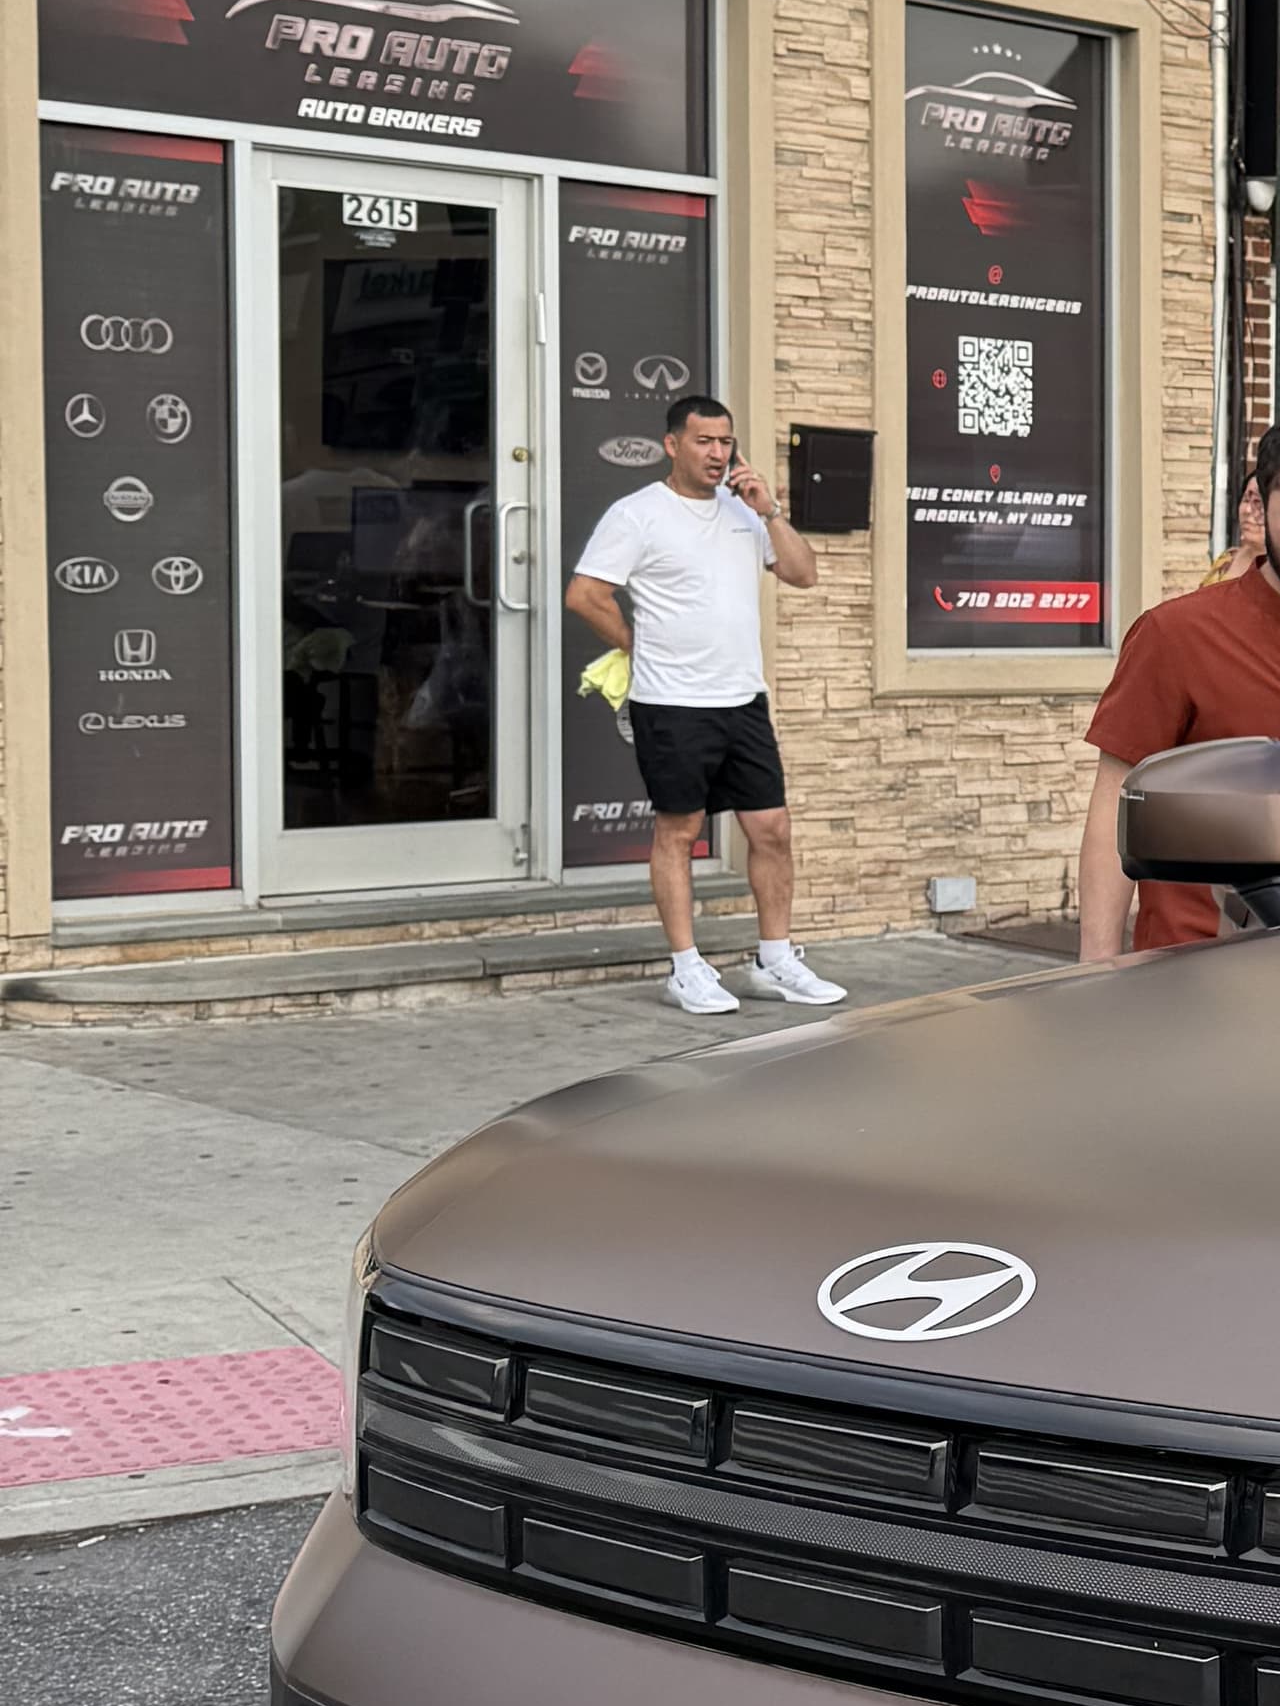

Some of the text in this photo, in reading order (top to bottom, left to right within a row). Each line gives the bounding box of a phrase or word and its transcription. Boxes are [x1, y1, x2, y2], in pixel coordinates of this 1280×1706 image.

[265, 13, 512, 79] PRO AUTO
[304, 63, 476, 103] LEASING
[298, 97, 484, 138] AUTO BROKERS
[921, 102, 1072, 146] PRO AUTO
[944, 134, 1050, 161] LEASING
[50, 171, 201, 204] PRO AUTO
[347, 195, 414, 228] 2615
[568, 224, 687, 253] PRO AUTO
[987, 264, 1004, 285] @
[613, 440, 652, 461] Ford
[941, 487, 994, 504] CONEY
[996, 491, 1055, 507] ISLAND
[1055, 493, 1088, 508] AVE
[1006, 511, 1029, 526] NY
[66, 564, 107, 585] KIA
[994, 591, 1035, 609] 902
[1037, 592, 1091, 610] 2277
[99, 669, 172, 682] HONDA
[108, 713, 188, 730] LEXUS
[572, 801, 625, 822] PRO
[61, 819, 209, 845] PRO AUTO
